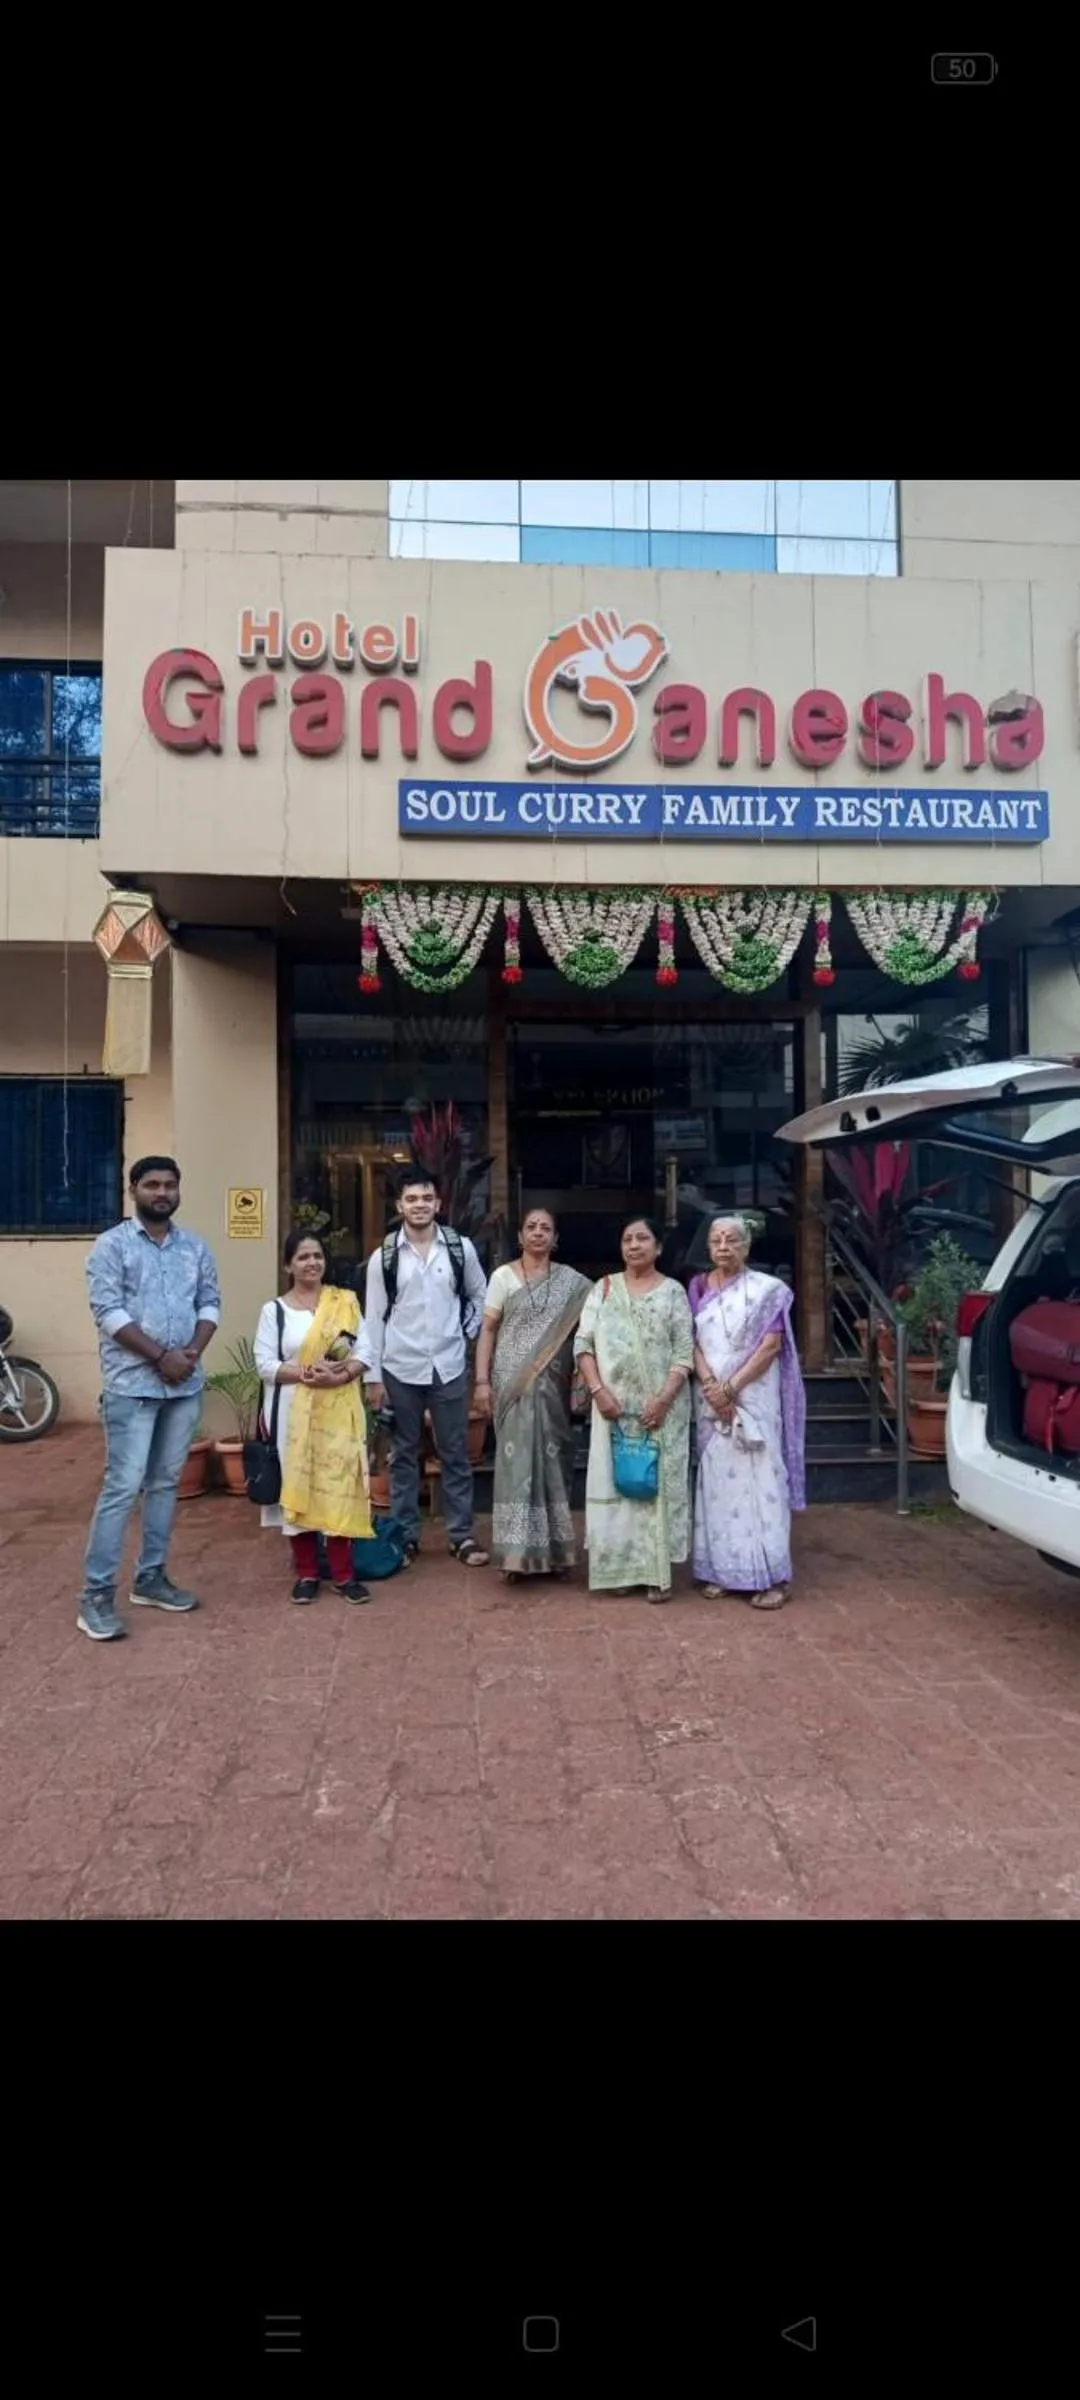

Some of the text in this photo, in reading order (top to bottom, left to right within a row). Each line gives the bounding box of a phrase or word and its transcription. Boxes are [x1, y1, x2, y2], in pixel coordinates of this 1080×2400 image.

[238, 608, 419, 672] Hotel
[142, 648, 493, 759] Grand
[406, 789, 1042, 828] SOUL CURRY FAMILY RESTAURANT
